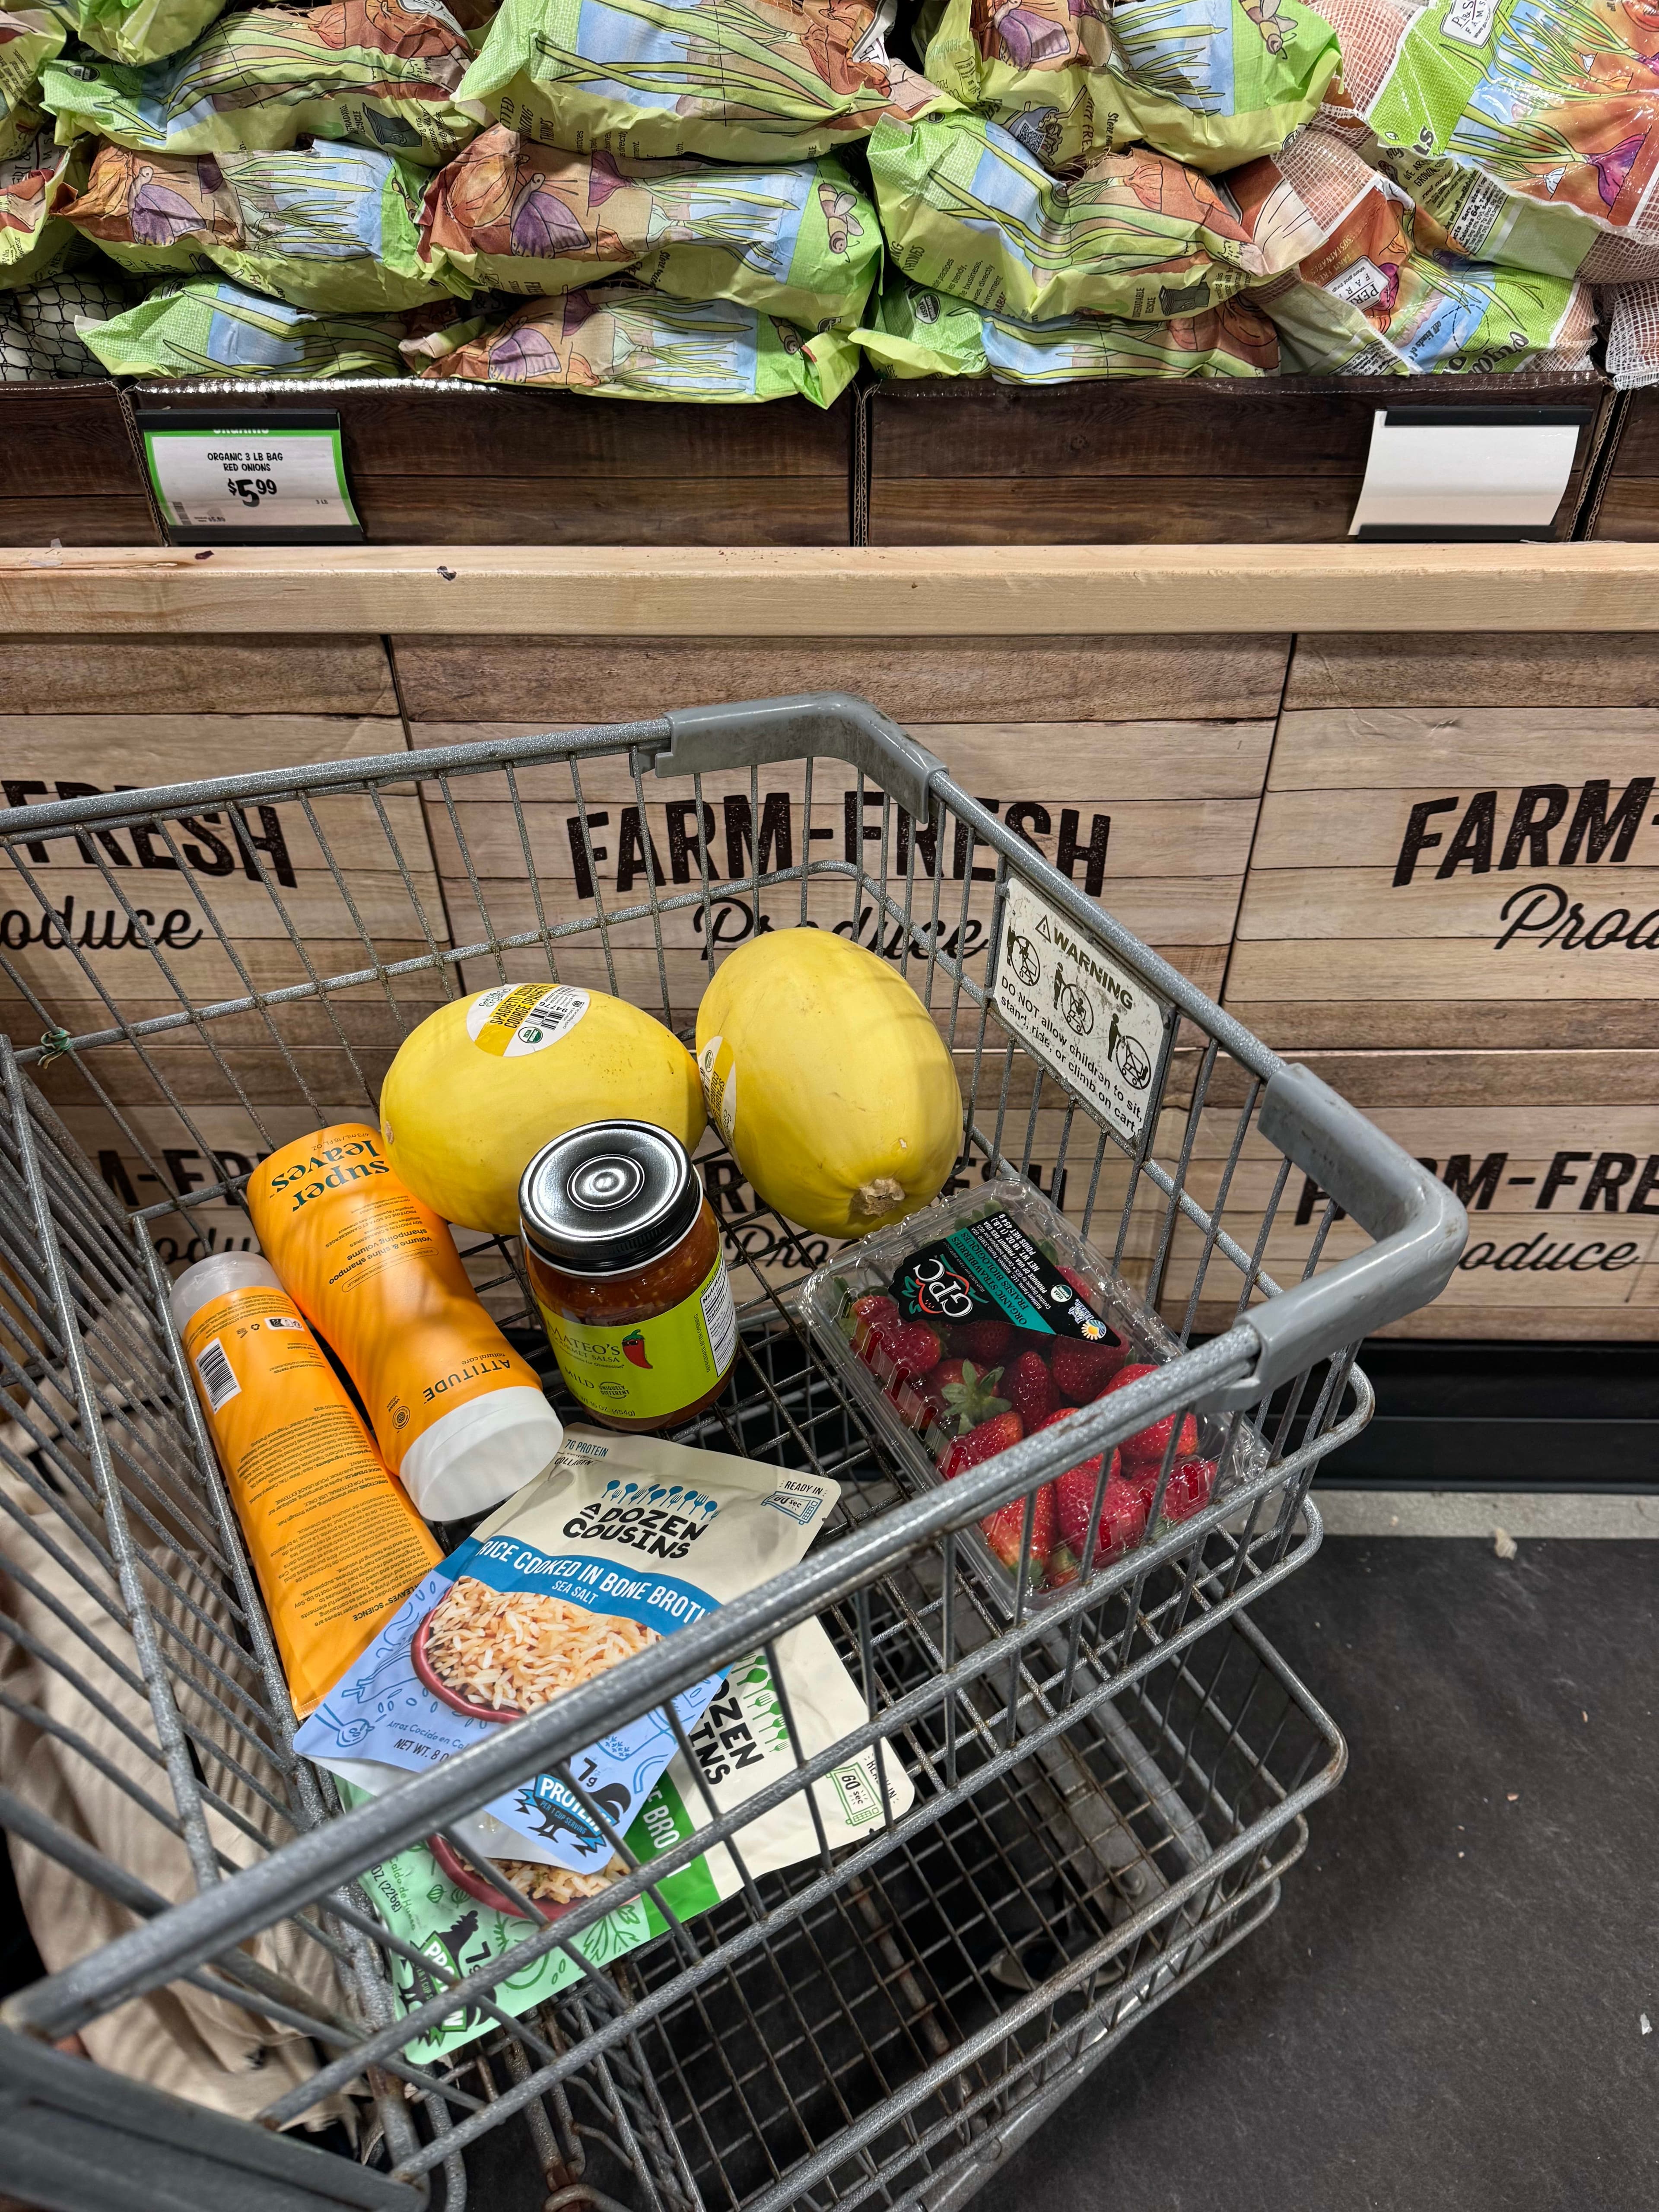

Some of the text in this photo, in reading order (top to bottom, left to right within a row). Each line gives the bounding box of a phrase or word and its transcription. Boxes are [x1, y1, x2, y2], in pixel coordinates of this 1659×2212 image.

[1106, 112, 1119, 133] Store
[1459, 217, 1475, 242] Calories
[658, 250, 670, 269] Store
[962, 258, 984, 290] business,
[977, 263, 996, 288] directly
[207, 452, 283, 461] ORGANIC 3 LB BAG
[224, 463, 270, 471] RED ONIONS
[1054, 927, 1133, 1010] WARNING
[489, 997, 523, 1023] SPAGHETTI
[503, 1004, 531, 1028] COURGE
[538, 1001, 568, 1014] 94776
[1001, 976, 1143, 1123] DO NOT allow children to sit,
[1031, 1023, 1052, 1053] ride,
[1055, 1050, 1068, 1065] or
[1068, 1061, 1096, 1093] climb
[1098, 1091, 1112, 1108] on
[1113, 1105, 1137, 1135] cart.
[271, 1139, 381, 1194] leaves
[292, 1159, 390, 1213] super
[971, 1227, 980, 1236] USA
[983, 1220, 993, 1230] USA
[990, 1216, 1003, 1230] LB.)
[1001, 1217, 1013, 1230] 454
[1010, 1227, 1023, 1239] NET
[400, 1236, 432, 1246] volume
[977, 1234, 989, 1247] 33810
[990, 1228, 1001, 1239] DES
[1004, 1233, 1015, 1244] OZ.
[346, 1229, 427, 1261] shampoing volume
[366, 1246, 391, 1260] shine
[986, 1245, 999, 1258] Florida
[997, 1237, 1016, 1257] PRODUIT
[1012, 1242, 1022, 1251] 16
[1018, 1249, 1030, 1261] WT.
[1019, 1237, 1036, 1255] POIDS
[1458, 1232, 1640, 1271] oduce
[327, 1257, 366, 1285] shampoo
[960, 1230, 1029, 1310] FRAISES BIOLOGIQUES
[1015, 1257, 1025, 1268] USA
[1028, 1259, 1040, 1272] NET
[912, 1258, 974, 1318] GPC
[951, 1235, 1028, 1326] ORGANIC STRAWBERRIES
[1017, 1280, 1030, 1294] Farms,
[1028, 1272, 1048, 1294] PRODUCE
[1027, 1292, 1042, 1309] Kathleen
[1053, 1289, 1064, 1300] USDA
[547, 1320, 620, 1356] MATEO'S
[461, 1351, 505, 1367] natural care
[422, 1359, 509, 1402] ATTITUDE
[565, 1367, 594, 1389] MILD
[611, 1408, 636, 1418] (454g)
[565, 1439, 576, 1449] 7G
[575, 1441, 608, 1457] PROTEIN
[554, 1456, 593, 1465] COLLAGEN
[784, 1481, 823, 1495] READY IN
[583, 1500, 602, 1516] A
[789, 1500, 802, 1508] sec
[597, 1507, 709, 1541] DOZEN
[563, 1517, 690, 1558] COUSINS
[476, 1539, 652, 1600] RICE COOKED IN BONE
[551, 1579, 599, 1605] SEA SALT
[352, 1601, 384, 1621] SCIENCE
[387, 1719, 450, 1745] Arroz Cocido en
[394, 1738, 441, 1761] NET WT. 8
[840, 1770, 864, 1805] 60 sec
[540, 1800, 551, 1811] PER
[554, 1810, 566, 1821] CUP
[564, 1817, 587, 1835] SERVING
[378, 1880, 403, 1913] (226g)
[397, 1885, 411, 1899] de
